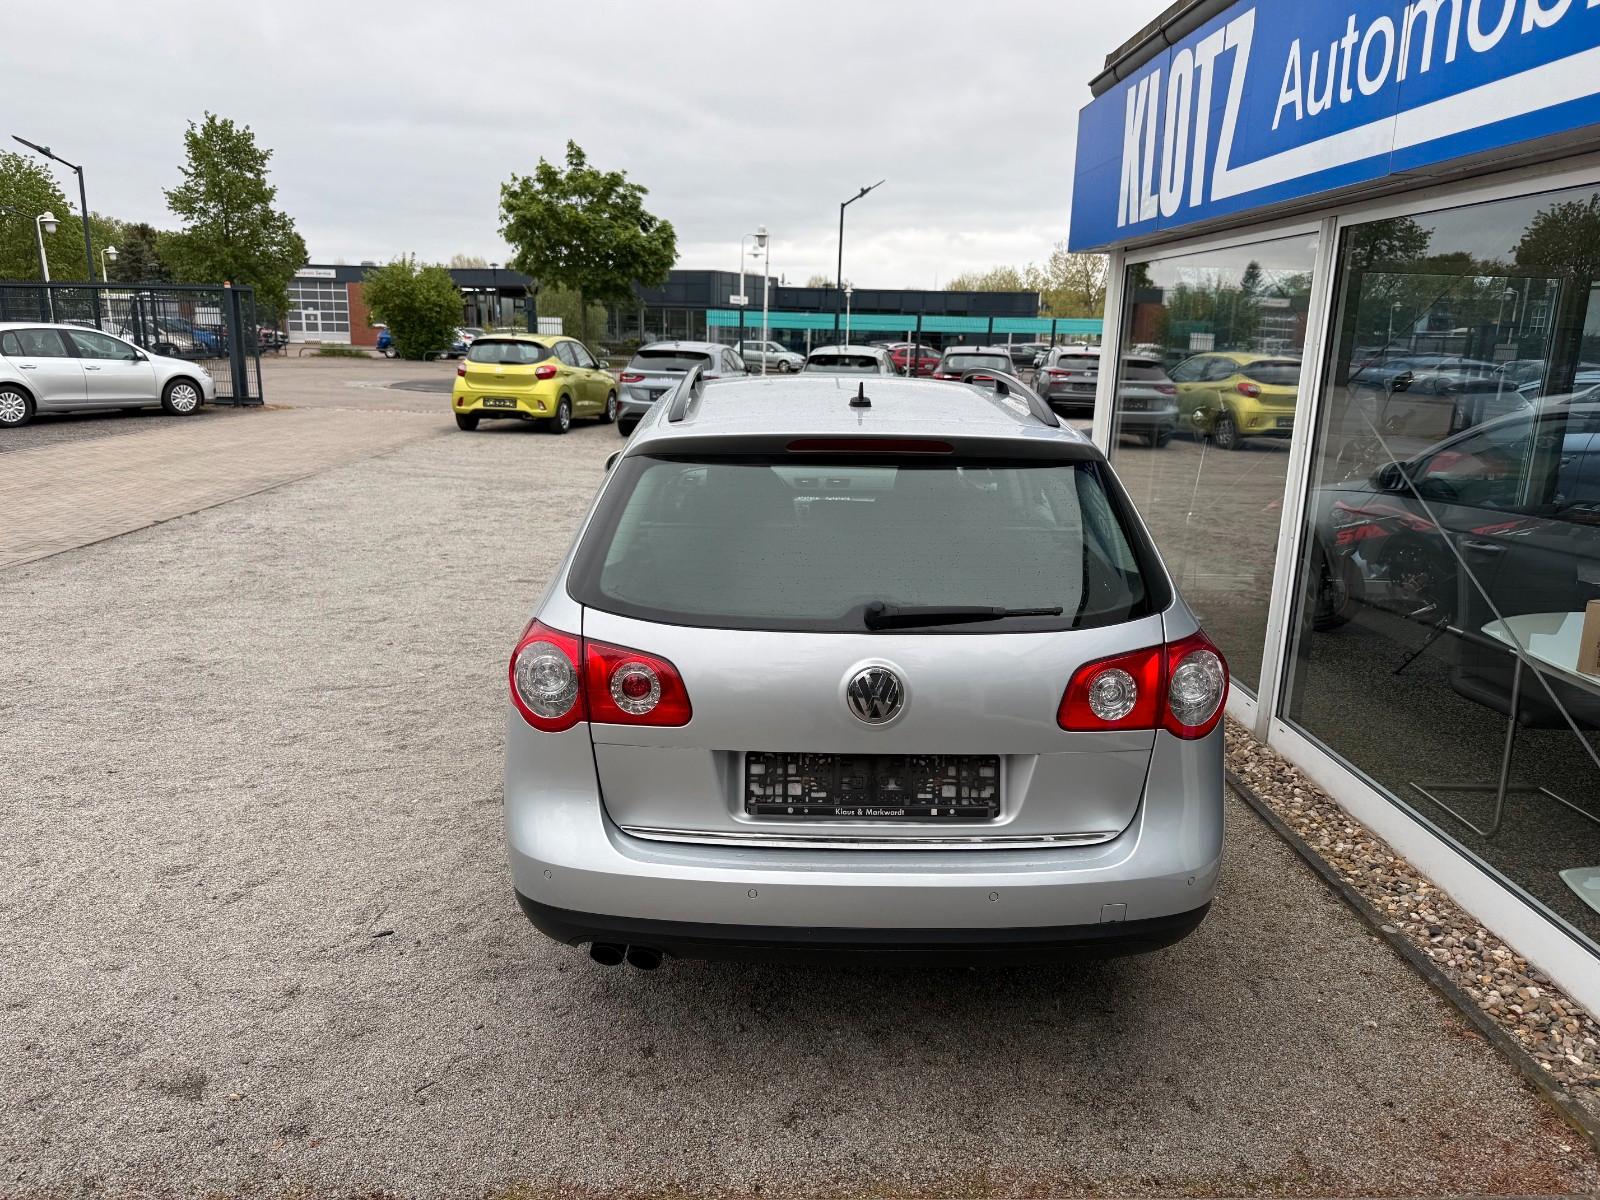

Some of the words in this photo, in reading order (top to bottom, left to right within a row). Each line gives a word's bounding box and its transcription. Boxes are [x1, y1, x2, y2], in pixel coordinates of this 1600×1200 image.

[1117, 8, 1256, 228] KLOTZ
[1271, 0, 1600, 130] Automob
[847, 666, 905, 725] VW
[835, 808, 855, 816] Klaus
[857, 808, 864, 816] &
[865, 808, 905, 816] Markwardt
